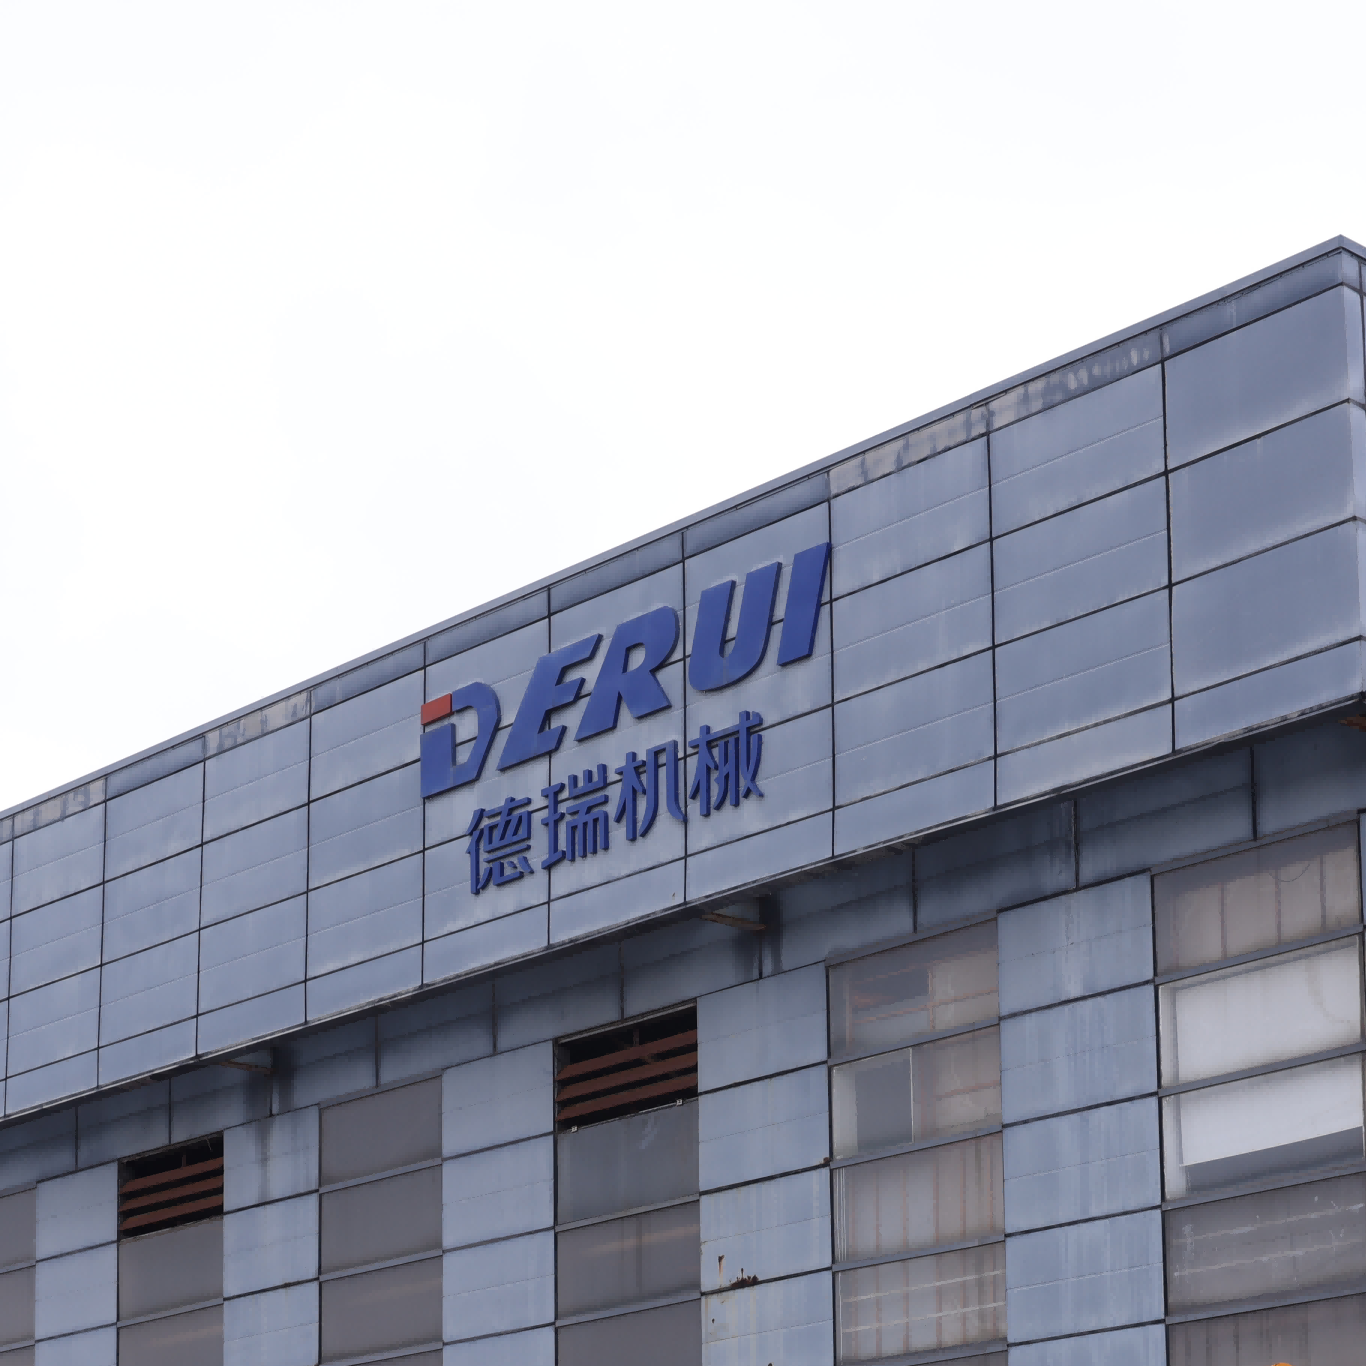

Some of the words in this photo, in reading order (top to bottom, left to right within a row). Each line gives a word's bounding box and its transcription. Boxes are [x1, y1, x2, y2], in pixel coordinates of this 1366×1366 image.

[420, 541, 831, 799] DERUI
[465, 710, 765, 895] 德瑞机械
